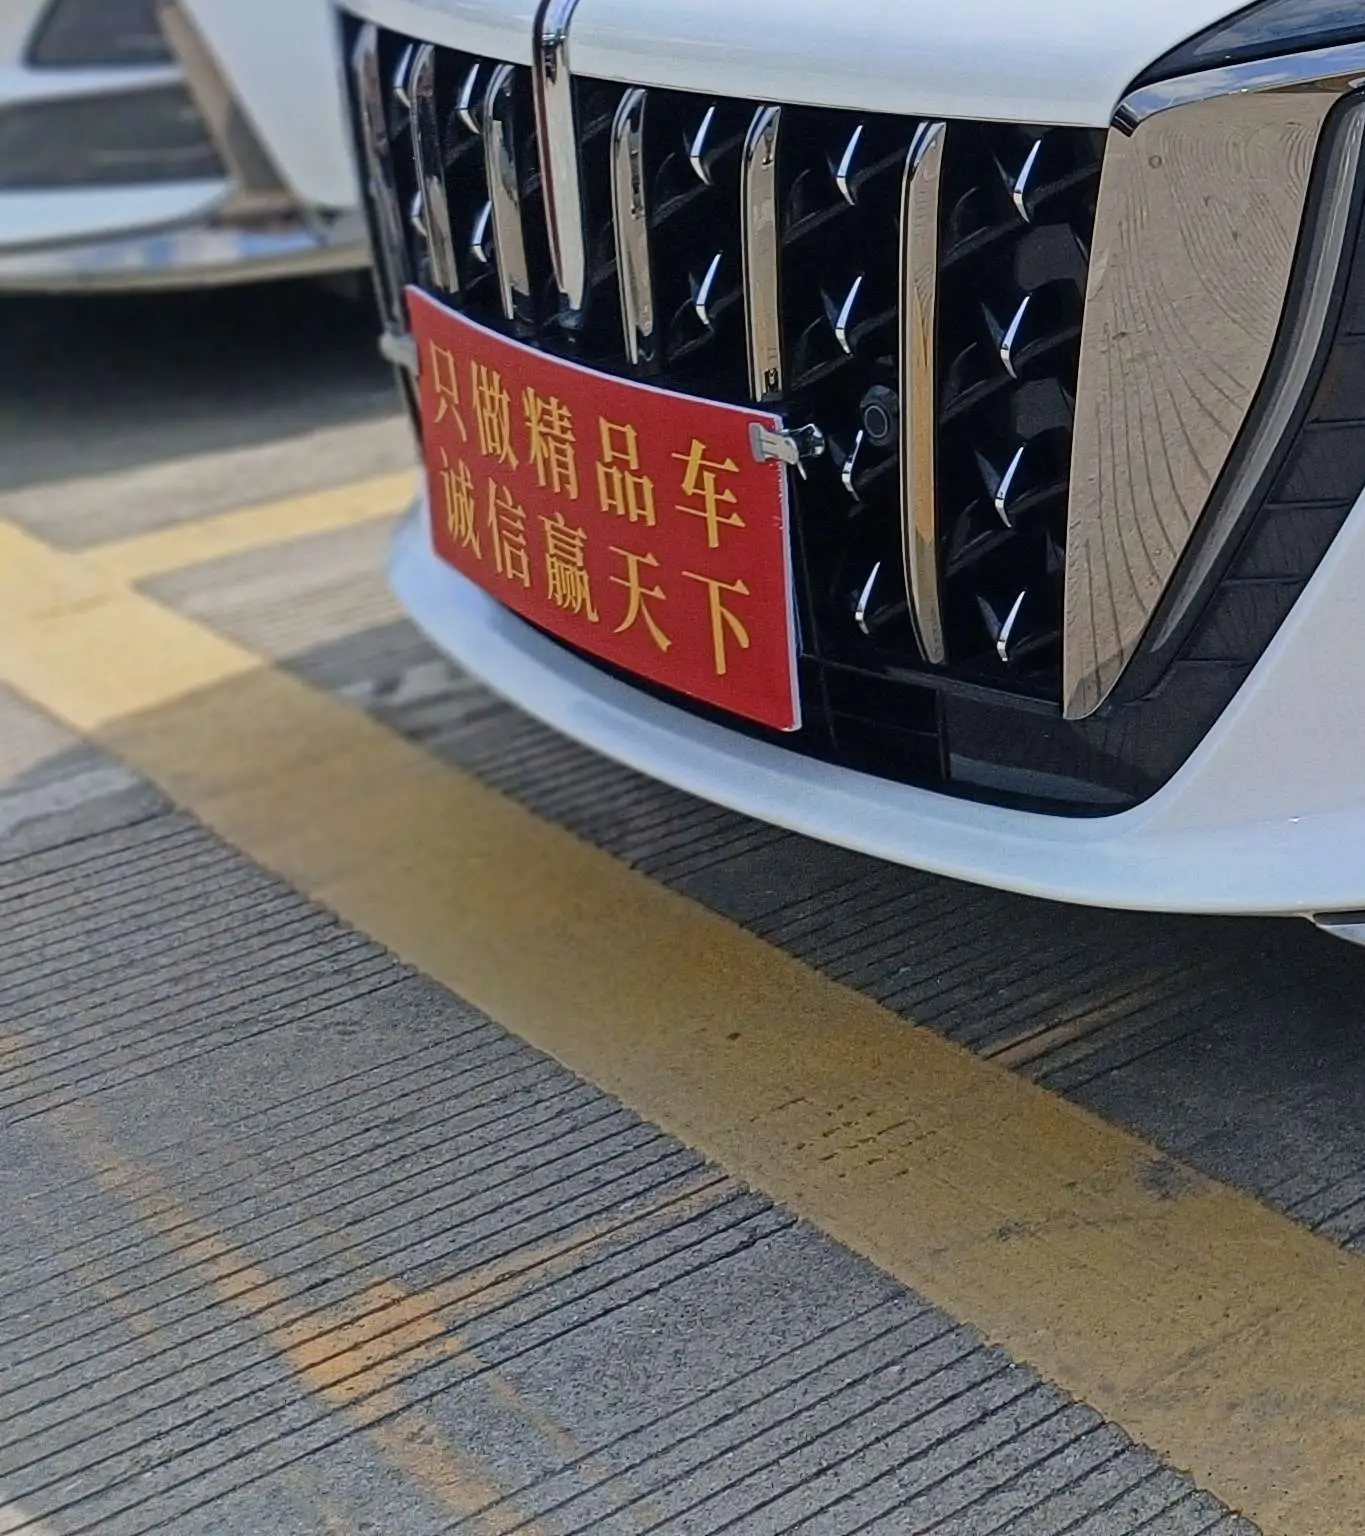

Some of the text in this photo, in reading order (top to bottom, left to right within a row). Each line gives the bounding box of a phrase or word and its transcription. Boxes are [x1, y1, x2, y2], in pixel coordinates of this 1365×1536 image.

[428, 339, 747, 549] 只做精品车
[439, 448, 751, 676] 诚信赢天下
